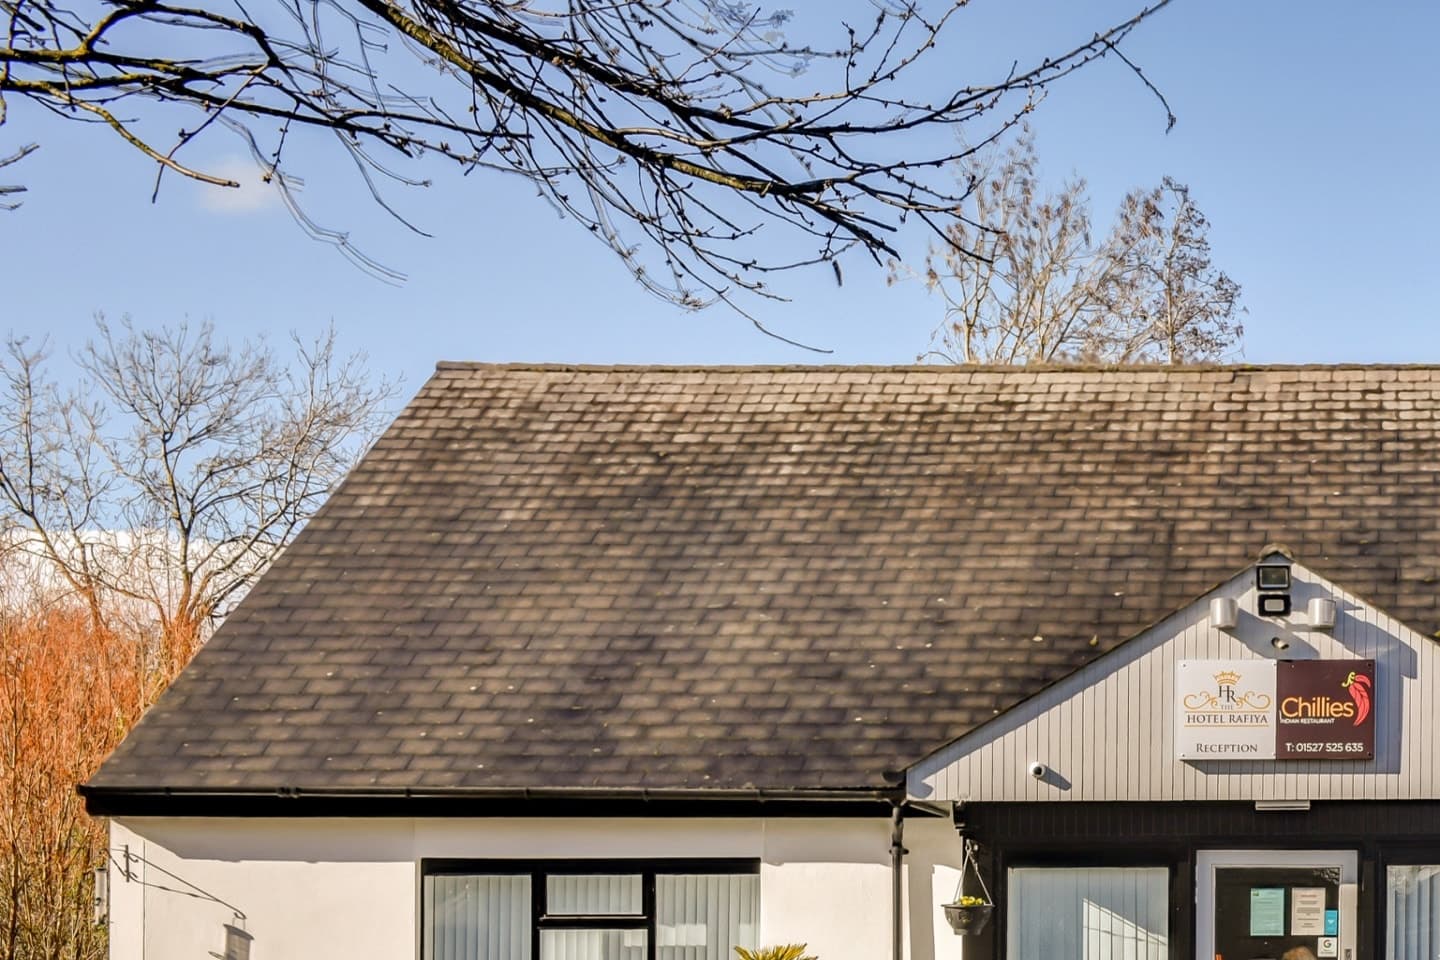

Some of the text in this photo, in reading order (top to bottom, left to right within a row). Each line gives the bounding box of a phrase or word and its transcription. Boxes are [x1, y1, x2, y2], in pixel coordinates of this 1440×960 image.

[1281, 696, 1354, 718] Chillies
[1187, 714, 1268, 723] HOTEL RAFIYA
[1196, 743, 1258, 753] RECEPTION
[1286, 743, 1364, 752] T: 01527 525 635
